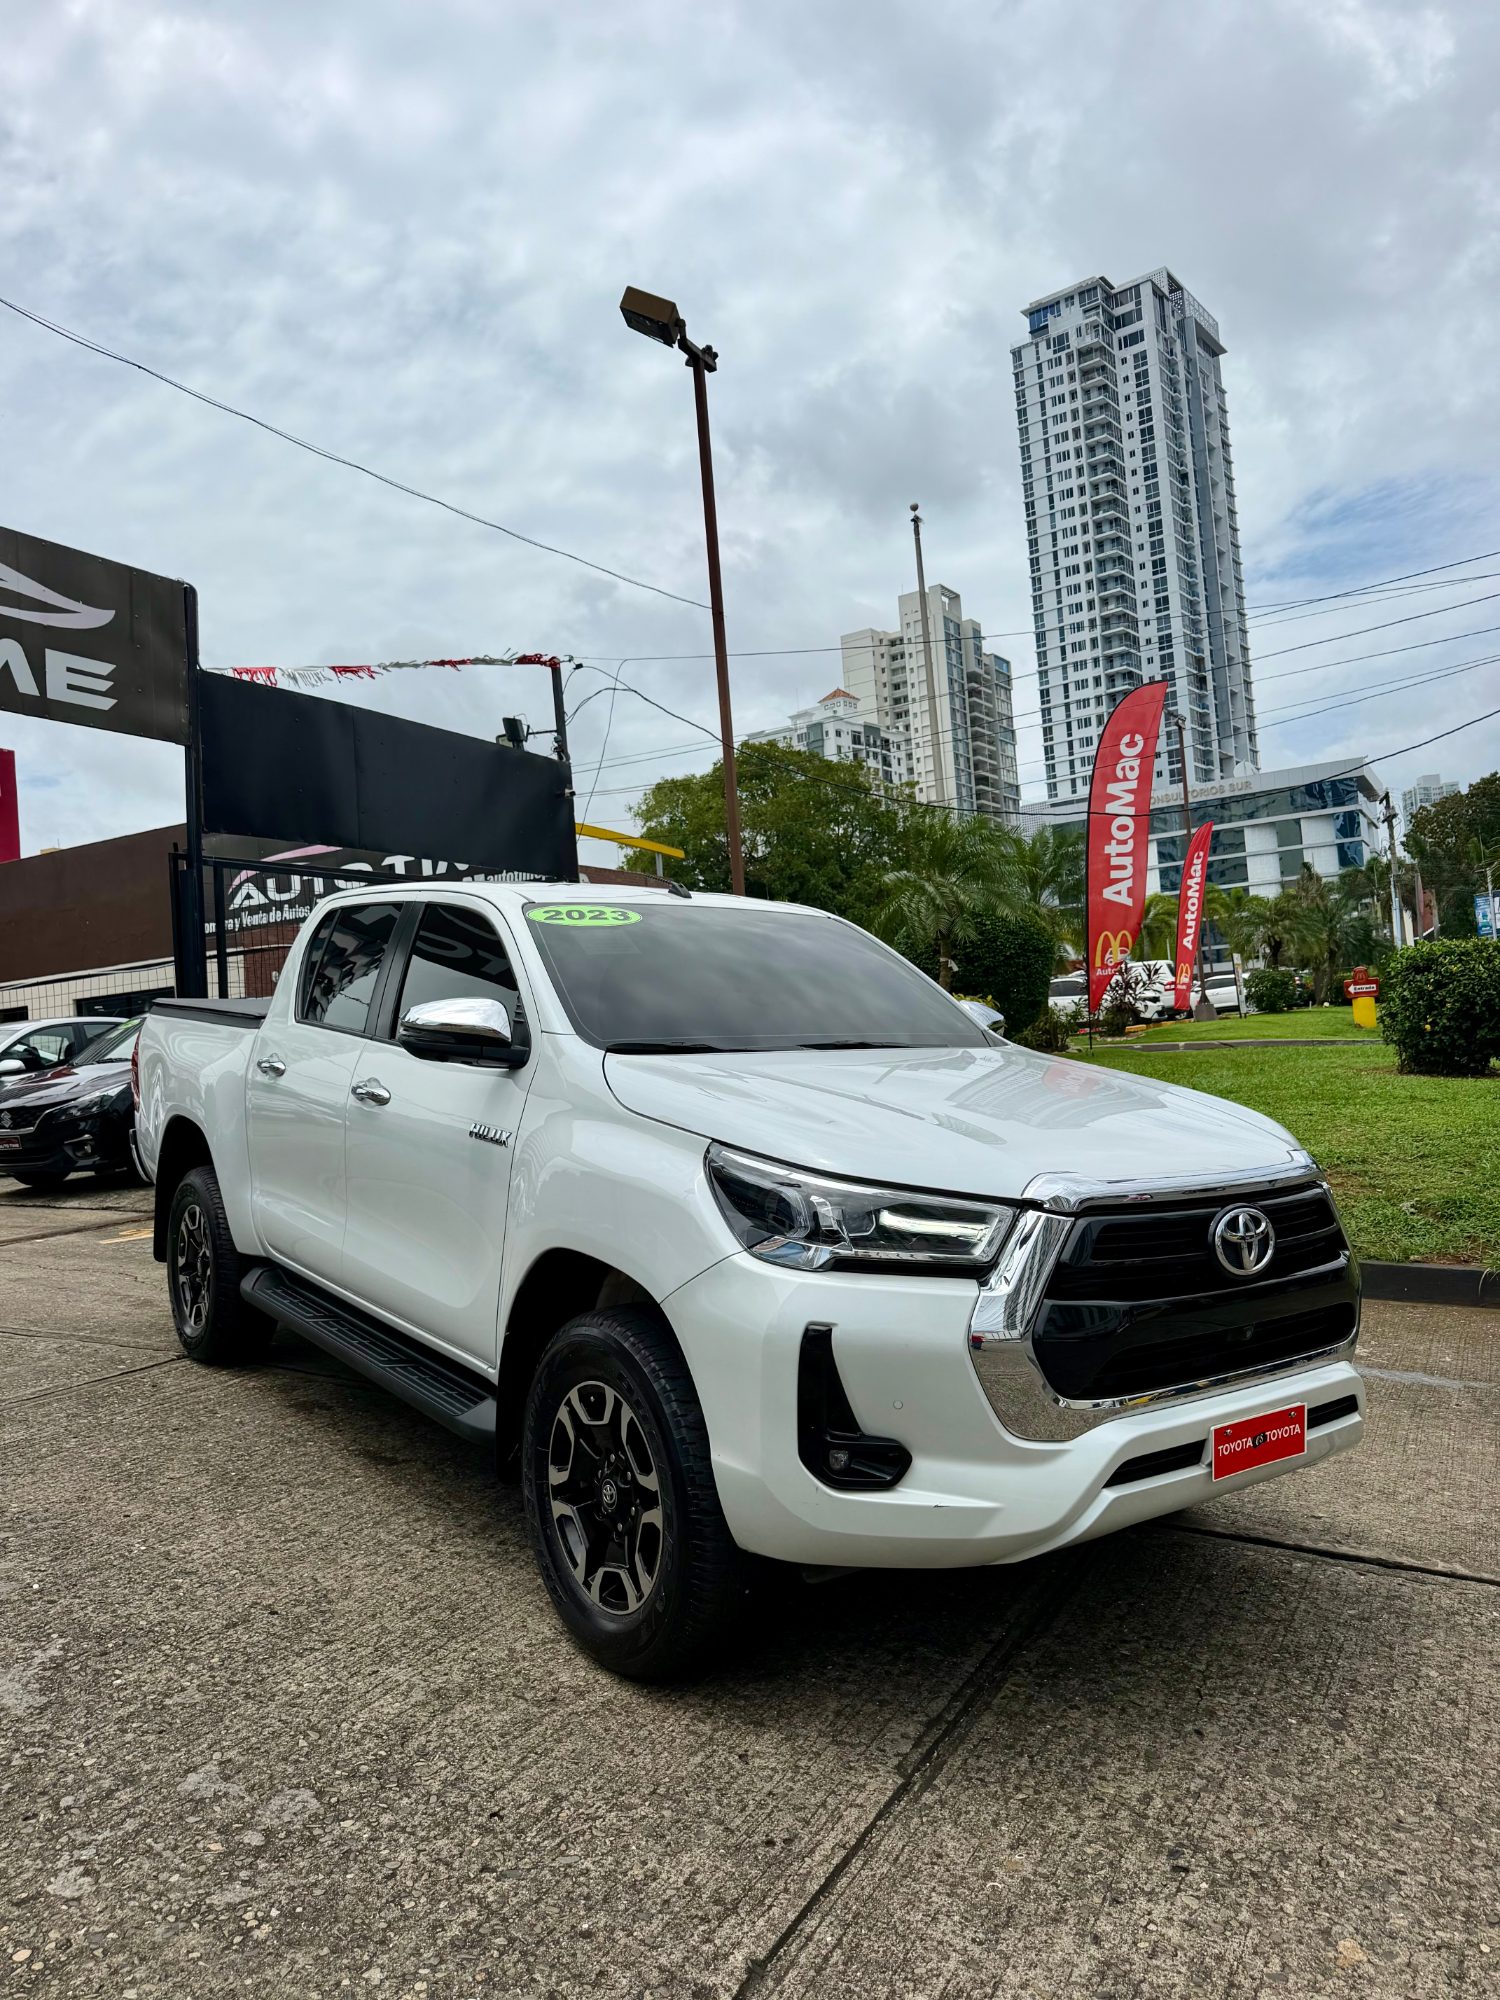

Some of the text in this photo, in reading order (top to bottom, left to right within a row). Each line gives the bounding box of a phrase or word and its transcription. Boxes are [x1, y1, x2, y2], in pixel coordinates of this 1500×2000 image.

[1150, 780, 1253, 805] ONSULORIOS SUR
[1103, 732, 1145, 907] AutoMac
[1183, 850, 1205, 951] AutoMac
[241, 910, 268, 928] Venta
[268, 906, 282, 922] de
[282, 904, 310, 922] Autos
[543, 908, 632, 922] 2023
[469, 1122, 512, 1148] HILUX
[1218, 1437, 1253, 1456] TOYOTA
[1265, 1423, 1301, 1442] TOYOTA
